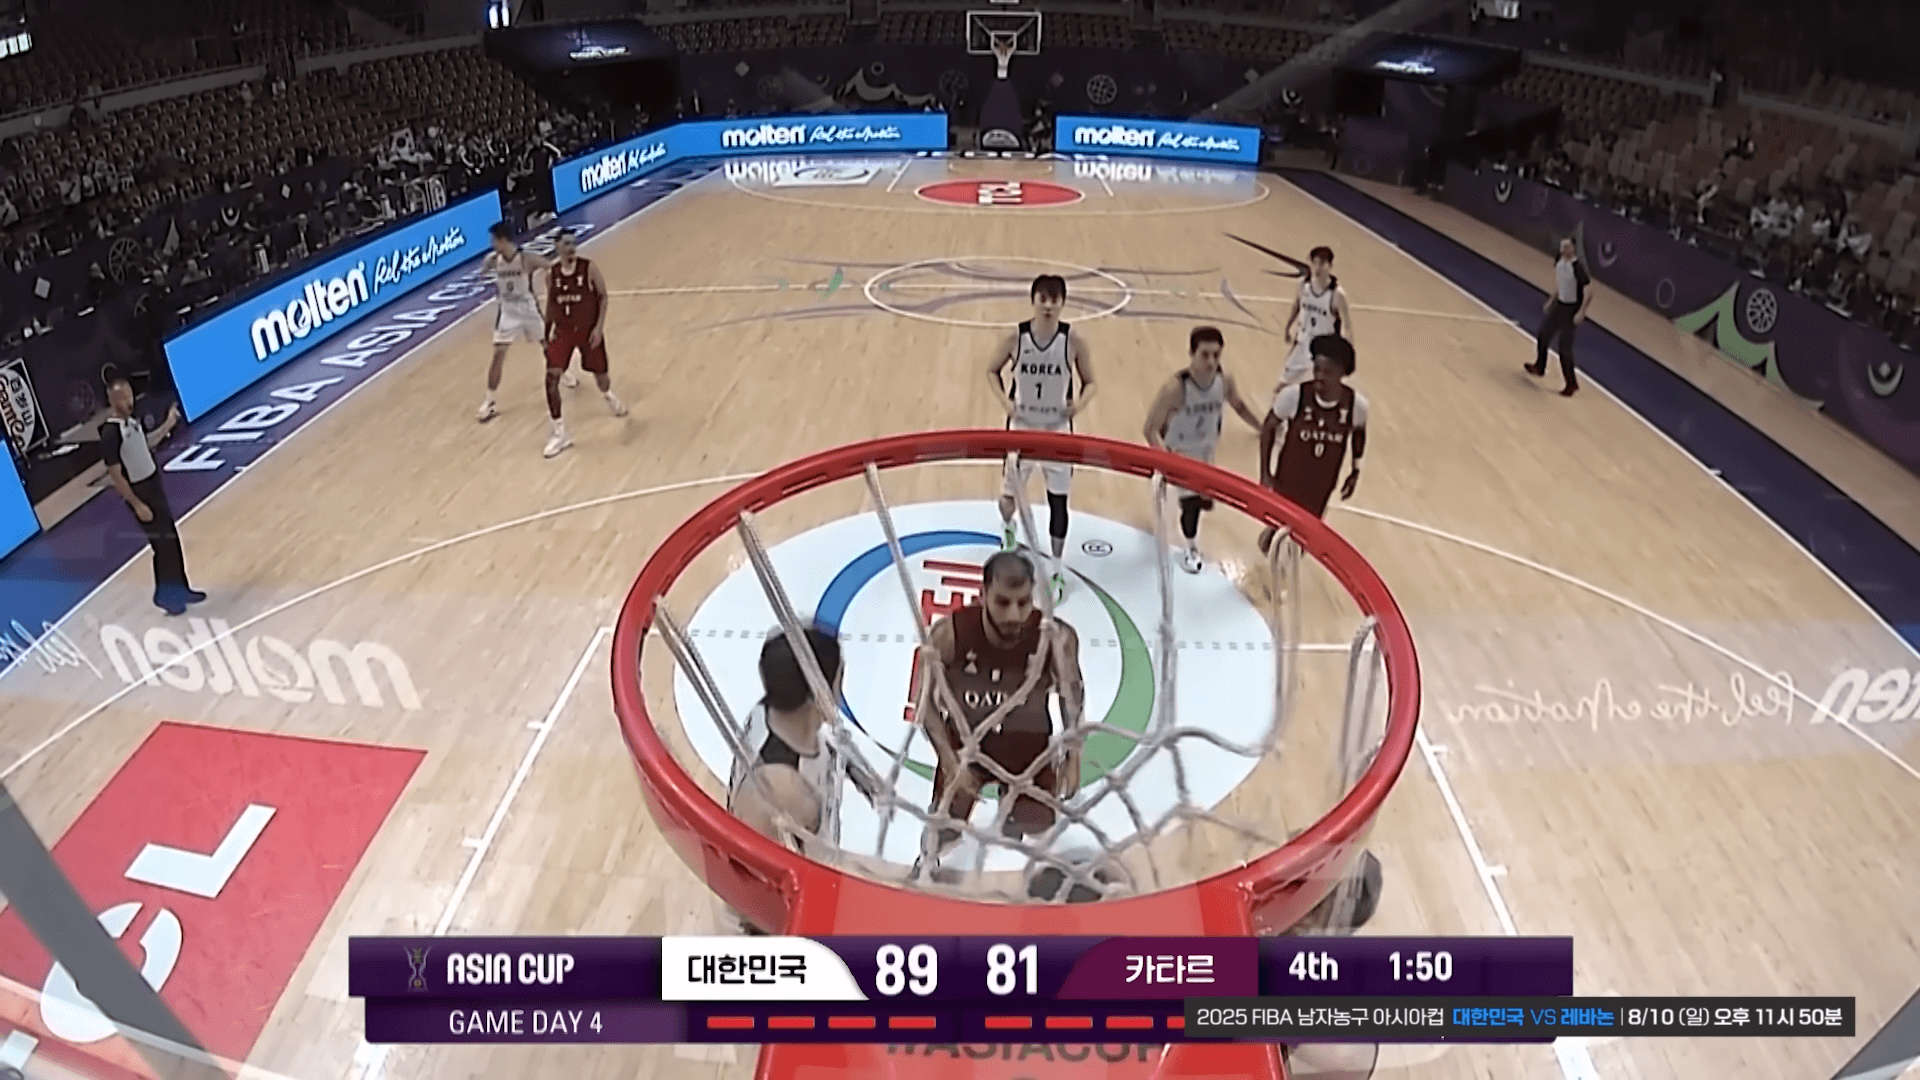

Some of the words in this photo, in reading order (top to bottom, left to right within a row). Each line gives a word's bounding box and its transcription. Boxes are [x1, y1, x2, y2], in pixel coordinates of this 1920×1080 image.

[722, 124, 806, 148] molten
[1074, 125, 1155, 148] molten
[581, 150, 627, 193] molten
[251, 261, 369, 361] molten
[1021, 363, 1062, 376] KOREA
[163, 375, 346, 472] FIBA
[320, 304, 457, 369] ASIA
[1035, 382, 1042, 400] 1
[1300, 429, 1344, 444] QATAR
[1314, 443, 1325, 458] 0
[0, 803, 277, 1070] CL
